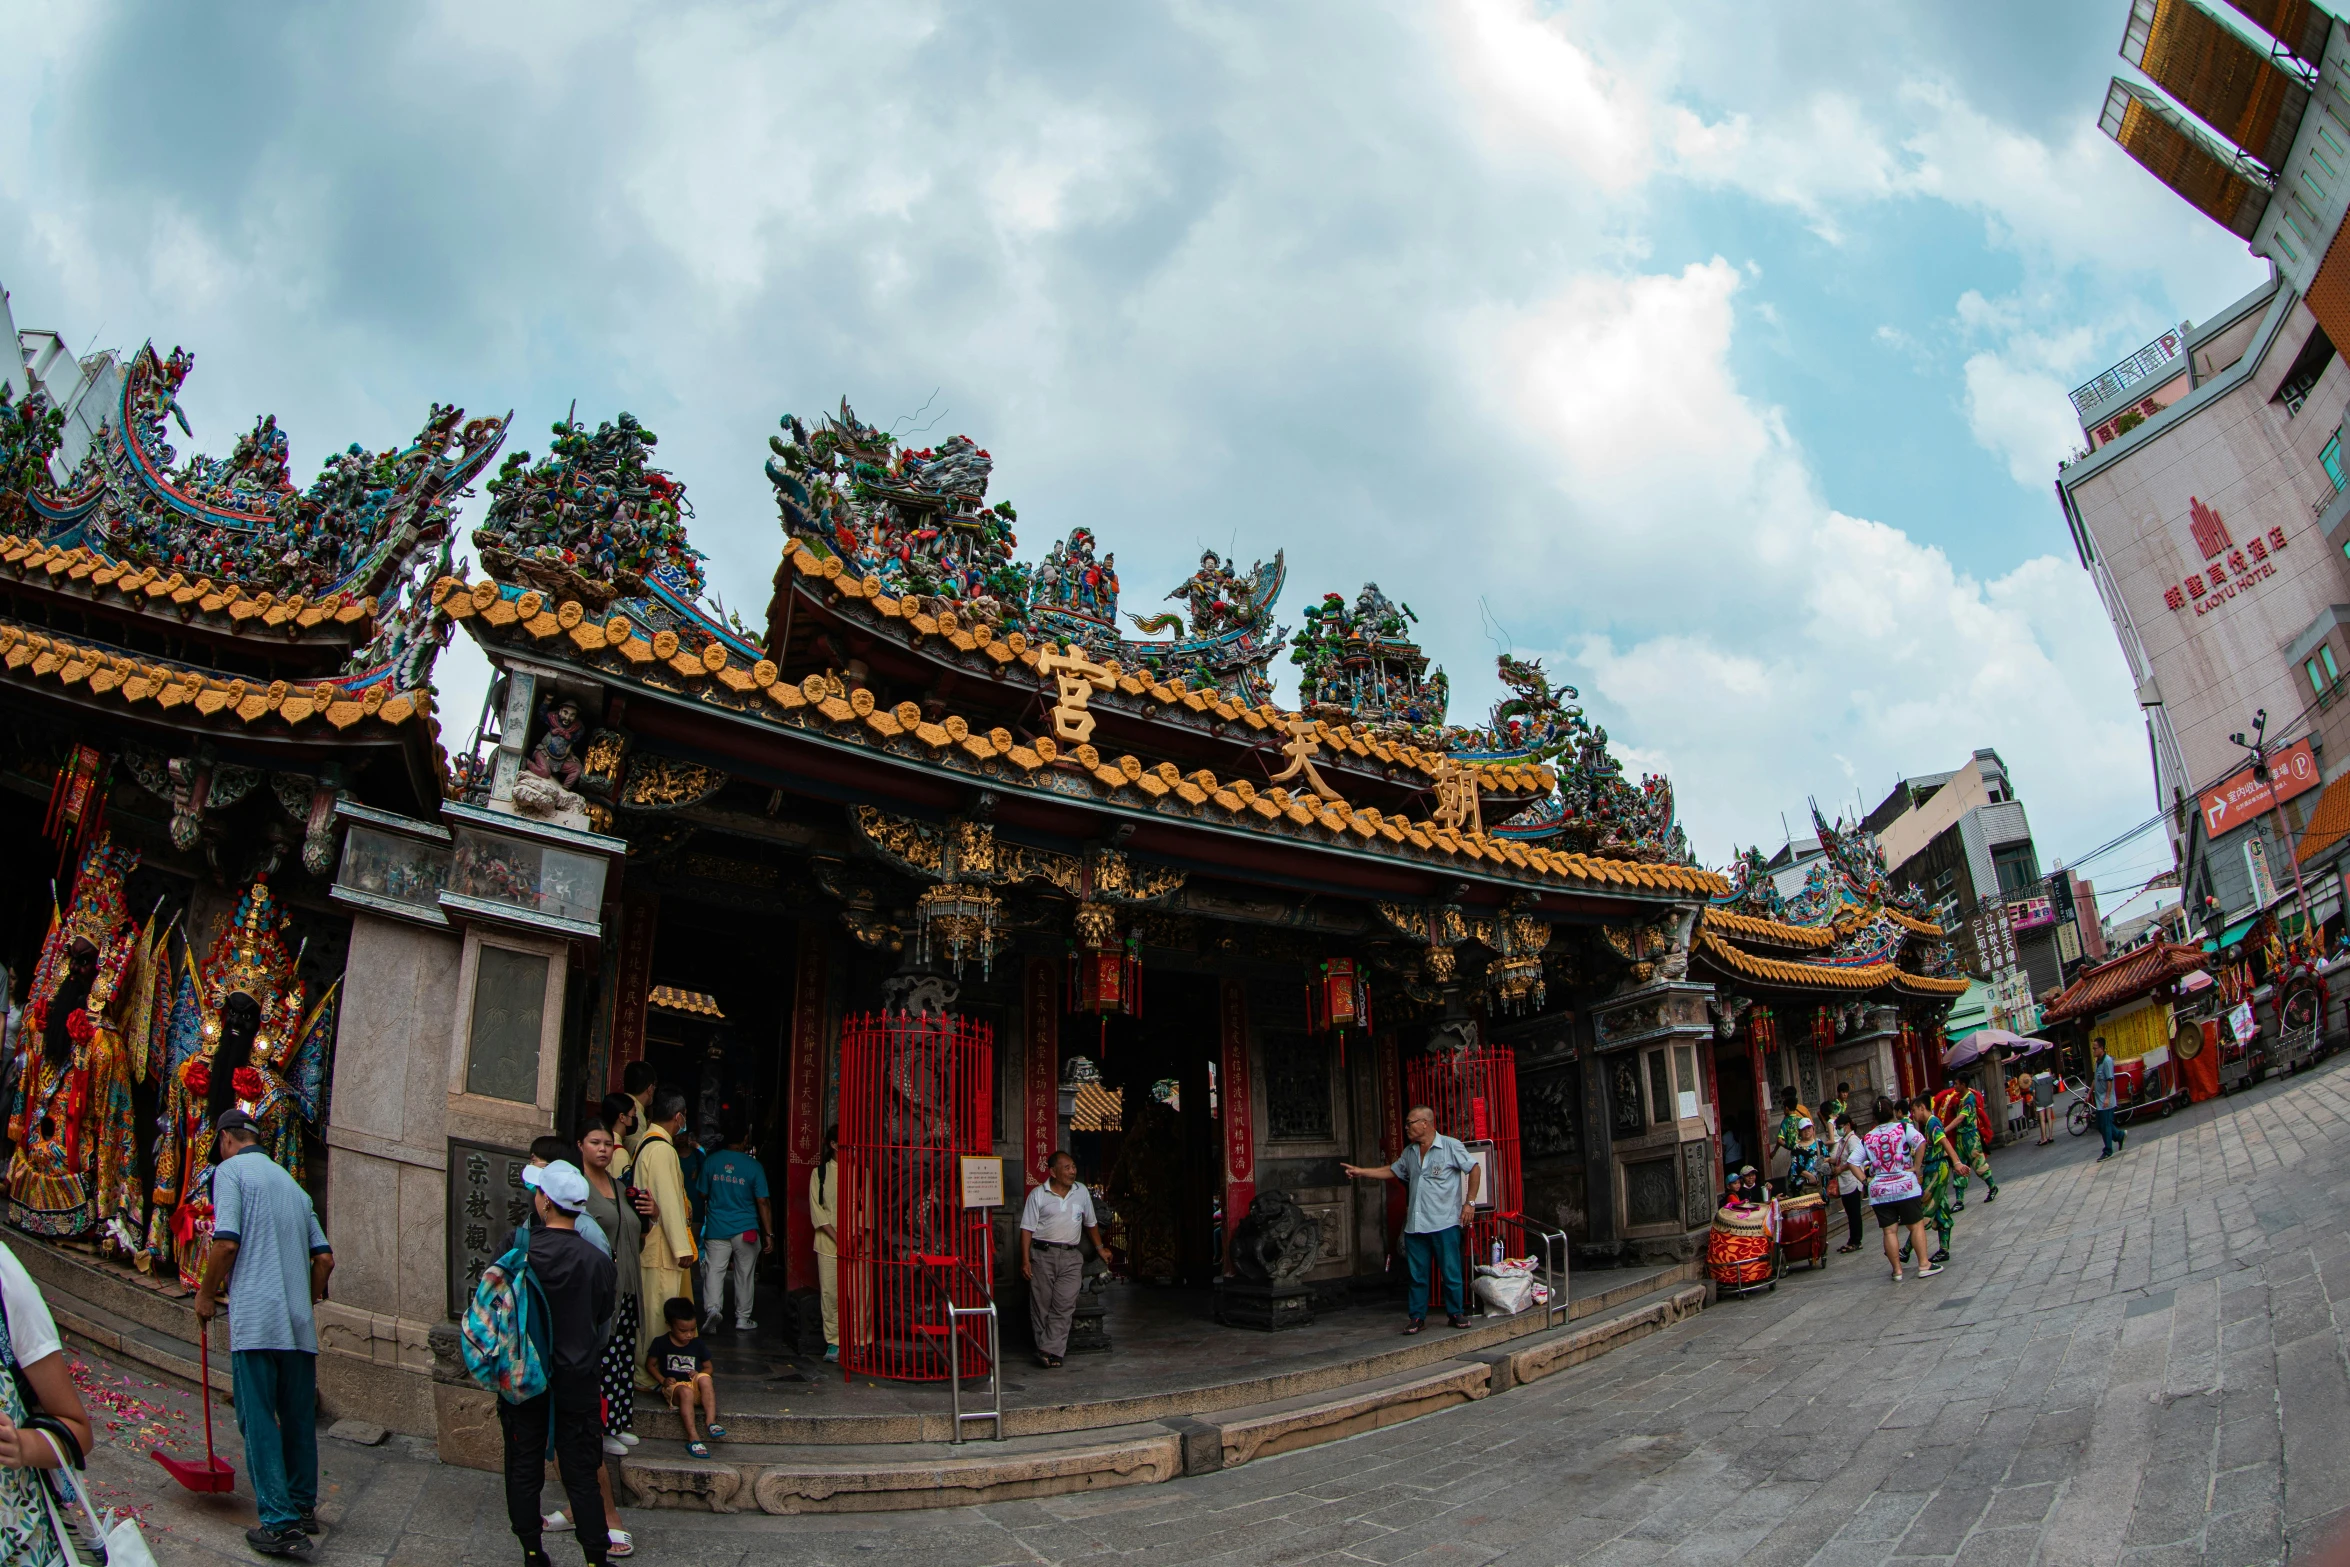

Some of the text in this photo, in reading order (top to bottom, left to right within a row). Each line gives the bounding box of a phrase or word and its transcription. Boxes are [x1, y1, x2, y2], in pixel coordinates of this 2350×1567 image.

[2164, 525, 2287, 611] 朝聖高悅酒店
[2194, 562, 2277, 617] KAOYU HOTEL
[1974, 928, 1991, 973] 仁和大樓
[1986, 923, 2003, 968] 中秋大樓
[1998, 917, 2016, 963] 厚生大樓
